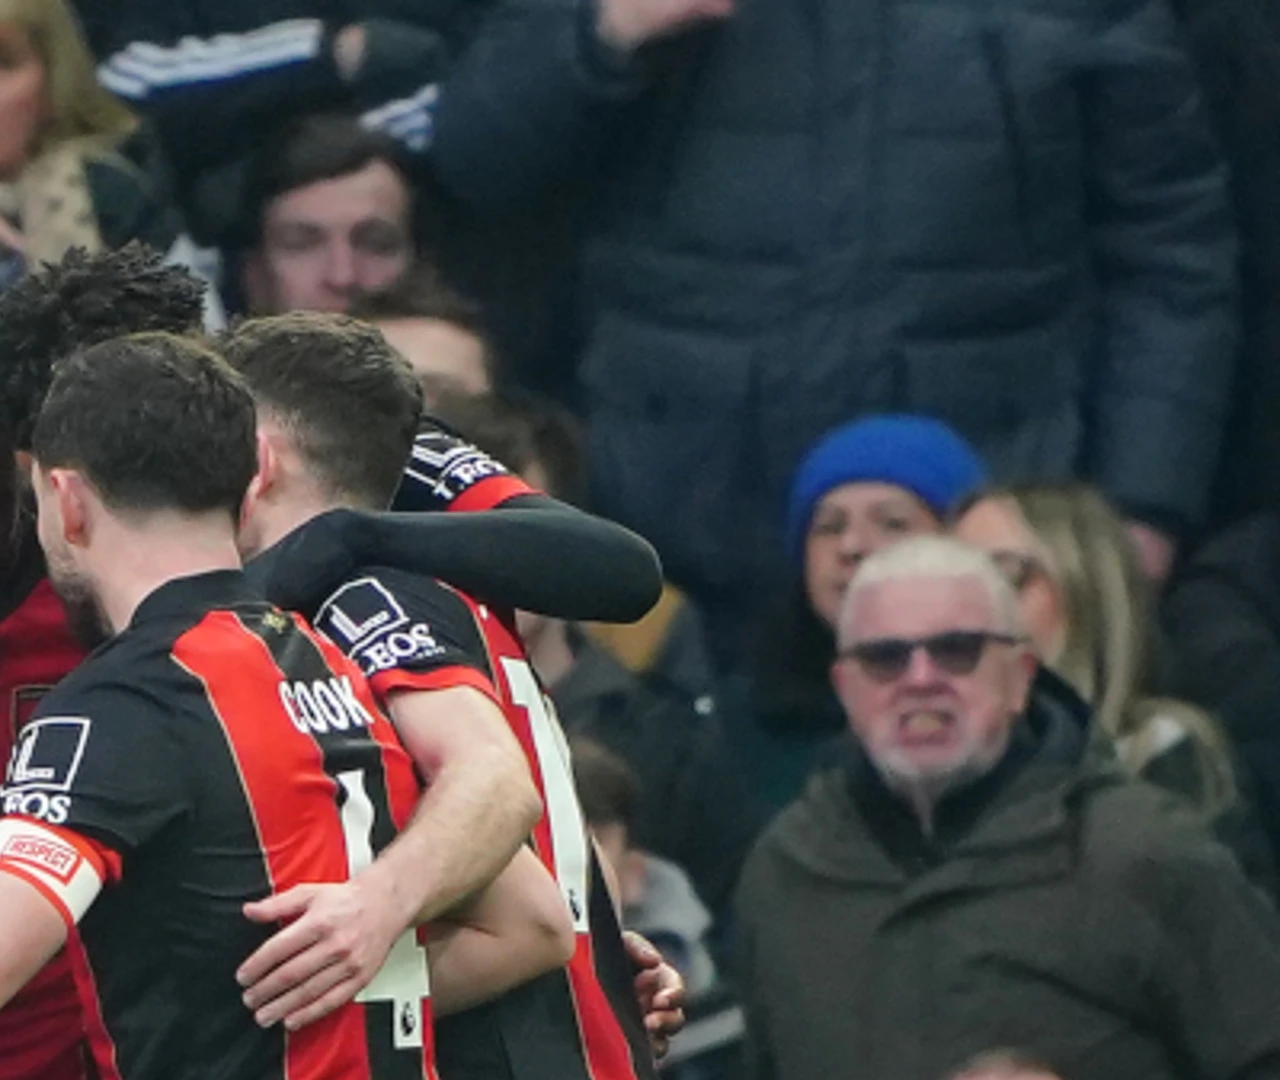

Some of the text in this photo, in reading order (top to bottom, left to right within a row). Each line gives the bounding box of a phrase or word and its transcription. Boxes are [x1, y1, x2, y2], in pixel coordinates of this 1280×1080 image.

[361, 622, 437, 677] EOS
[278, 674, 375, 734] COOK
[9, 839, 73, 871] RESPECT
